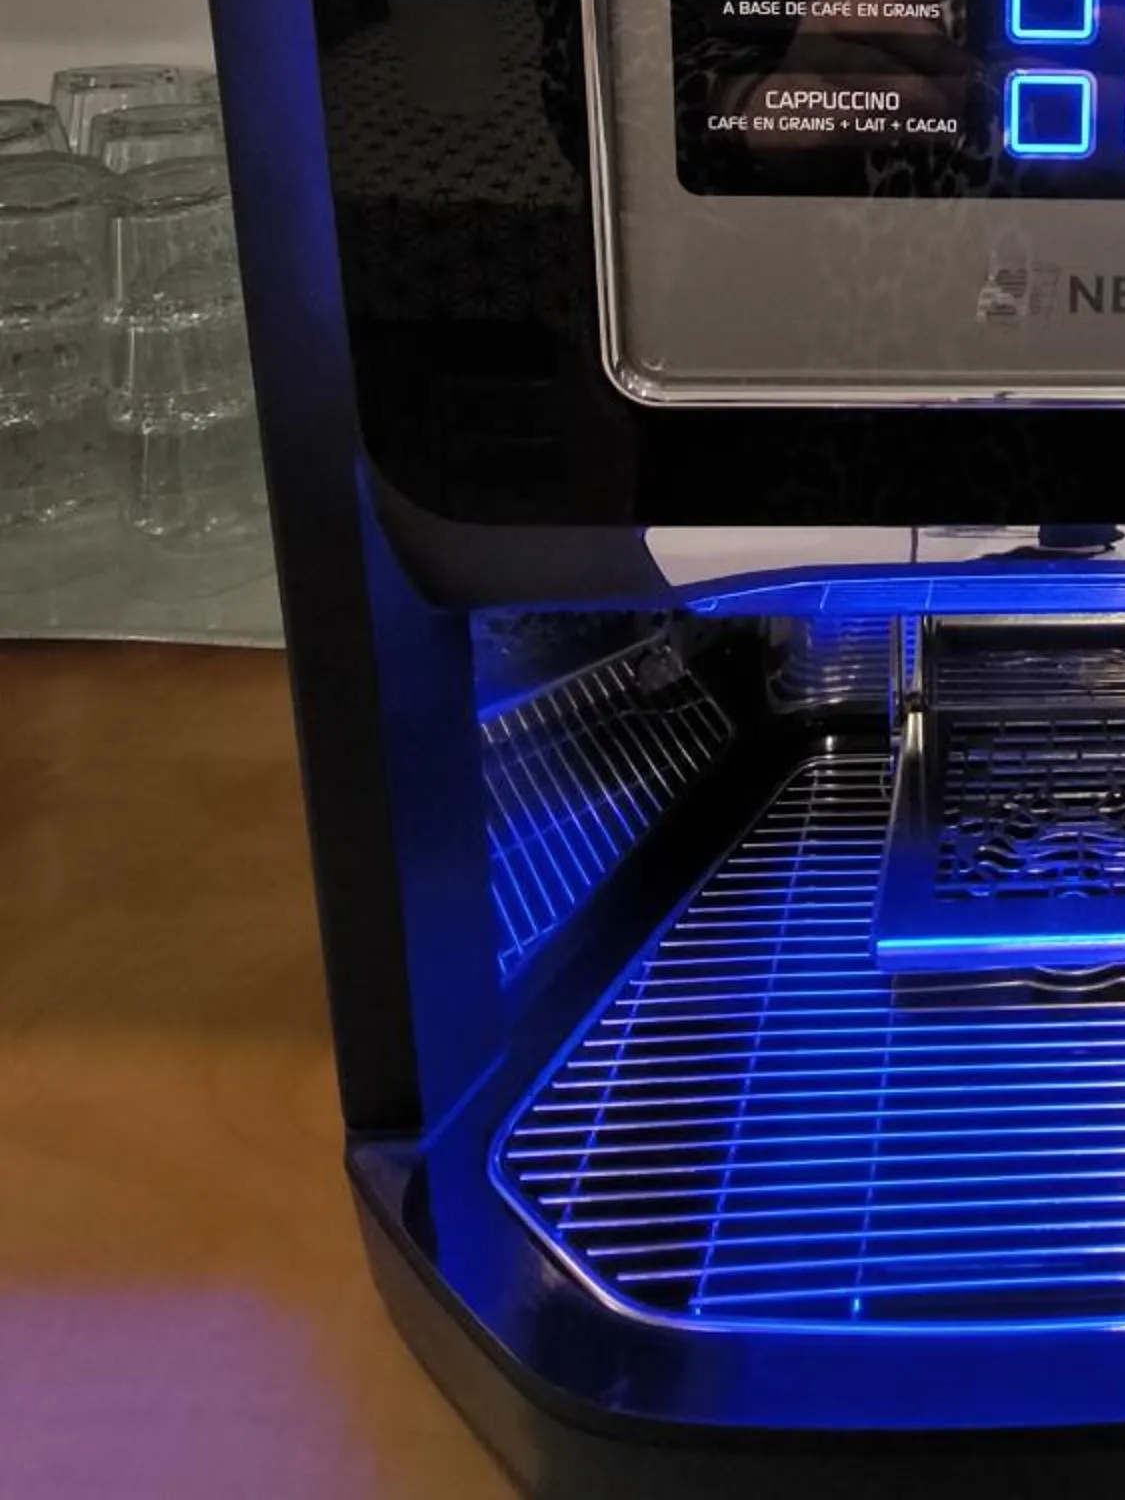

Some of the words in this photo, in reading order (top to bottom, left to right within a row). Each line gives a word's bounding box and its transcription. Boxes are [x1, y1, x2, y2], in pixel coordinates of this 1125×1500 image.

[738, 1, 781, 16] BASE
[785, 1, 806, 17] DE
[857, 3, 878, 18] EN
[883, 3, 940, 19] GRAINS
[764, 89, 901, 111] CAPPUCCINO
[753, 116, 775, 131] EN
[779, 116, 835, 131] GRAINS
[855, 117, 885, 132] LAIT
[906, 118, 958, 133] CACAO
